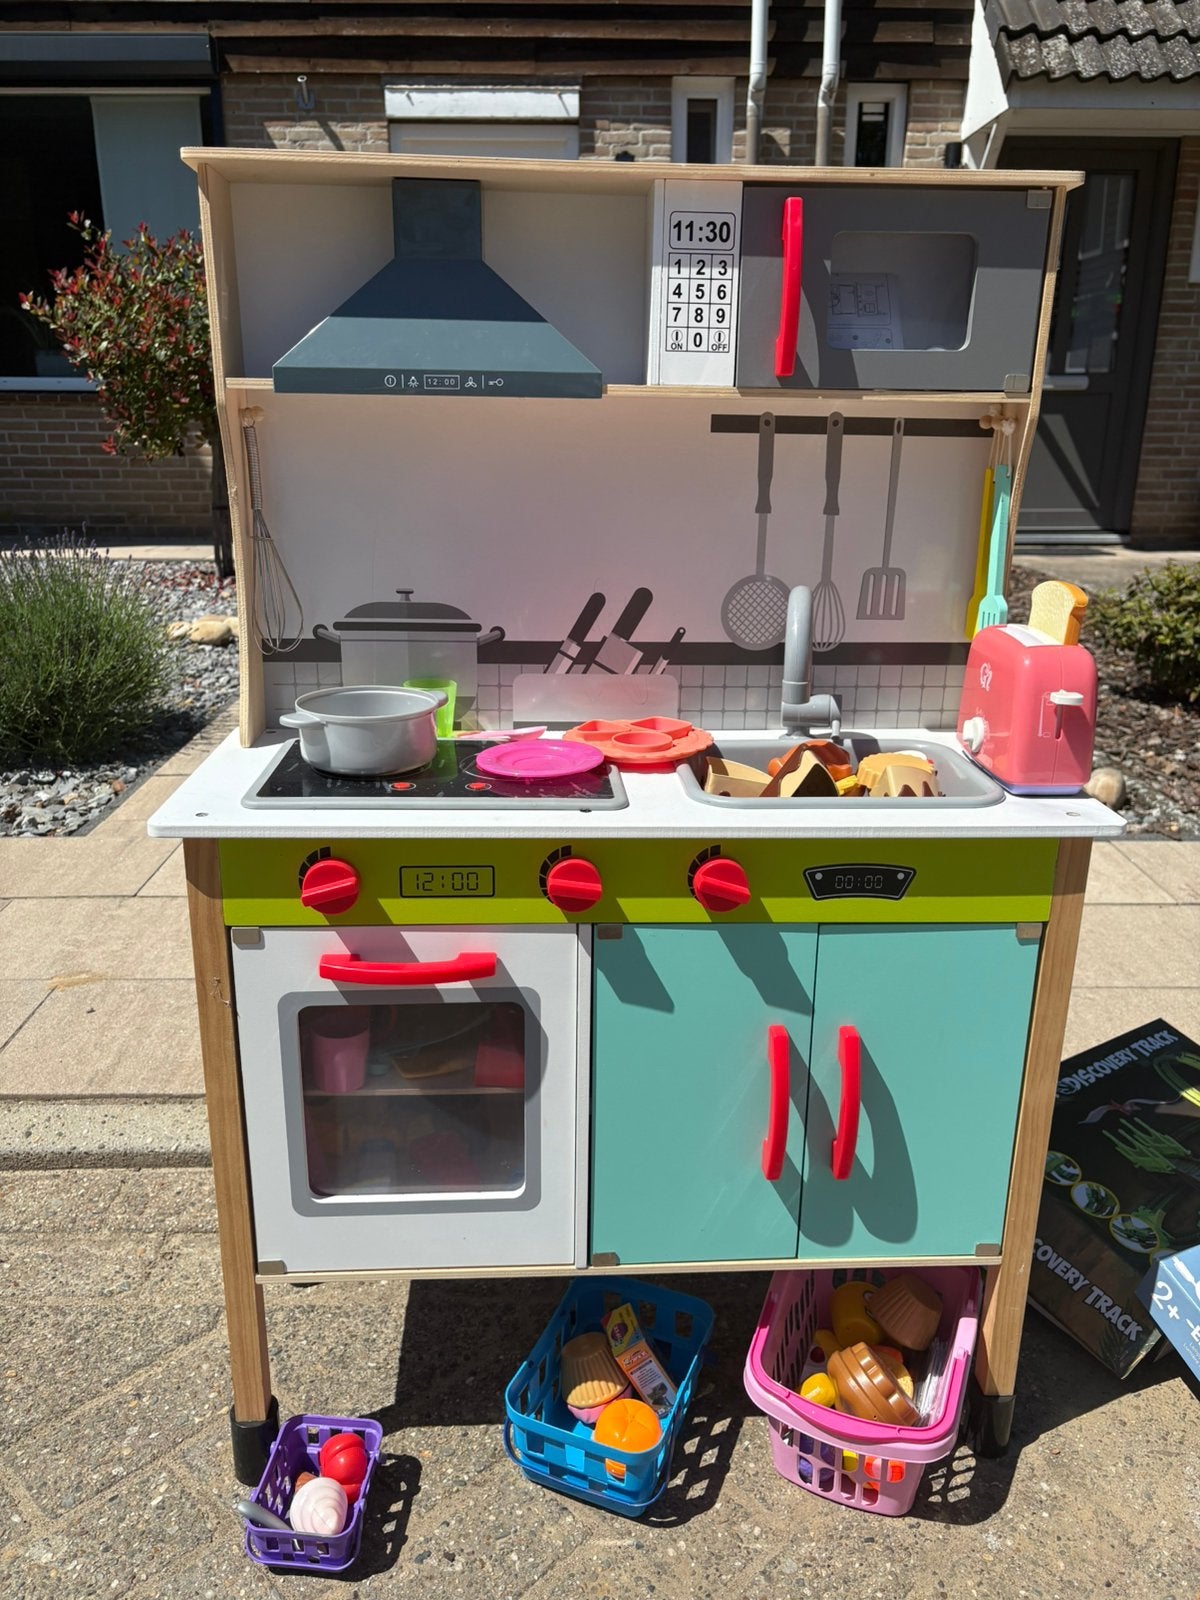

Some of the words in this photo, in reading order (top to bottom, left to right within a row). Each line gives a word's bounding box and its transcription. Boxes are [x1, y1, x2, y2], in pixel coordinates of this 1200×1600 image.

[673, 220, 731, 243] 11:30
[674, 258, 682, 275] 1
[695, 259, 706, 276] 2
[718, 260, 728, 276] 3
[672, 283, 682, 299] 4
[695, 284, 705, 300] 5
[717, 284, 727, 300] 6
[672, 307, 682, 322] 7
[694, 308, 703, 323] 8
[716, 308, 726, 324] 9
[670, 342, 683, 350] ON
[693, 332, 703, 348] 0
[711, 343, 727, 351] OFF
[427, 378, 456, 386] 12:00
[416, 872, 479, 891] 12:00
[835, 875, 883, 889] 00:00
[1057, 1047, 1138, 1095] DISCOVERY
[1130, 1029, 1179, 1057] TRACK
[1152, 1280, 1180, 1320] 2+
[1084, 1285, 1143, 1342] TRACK
